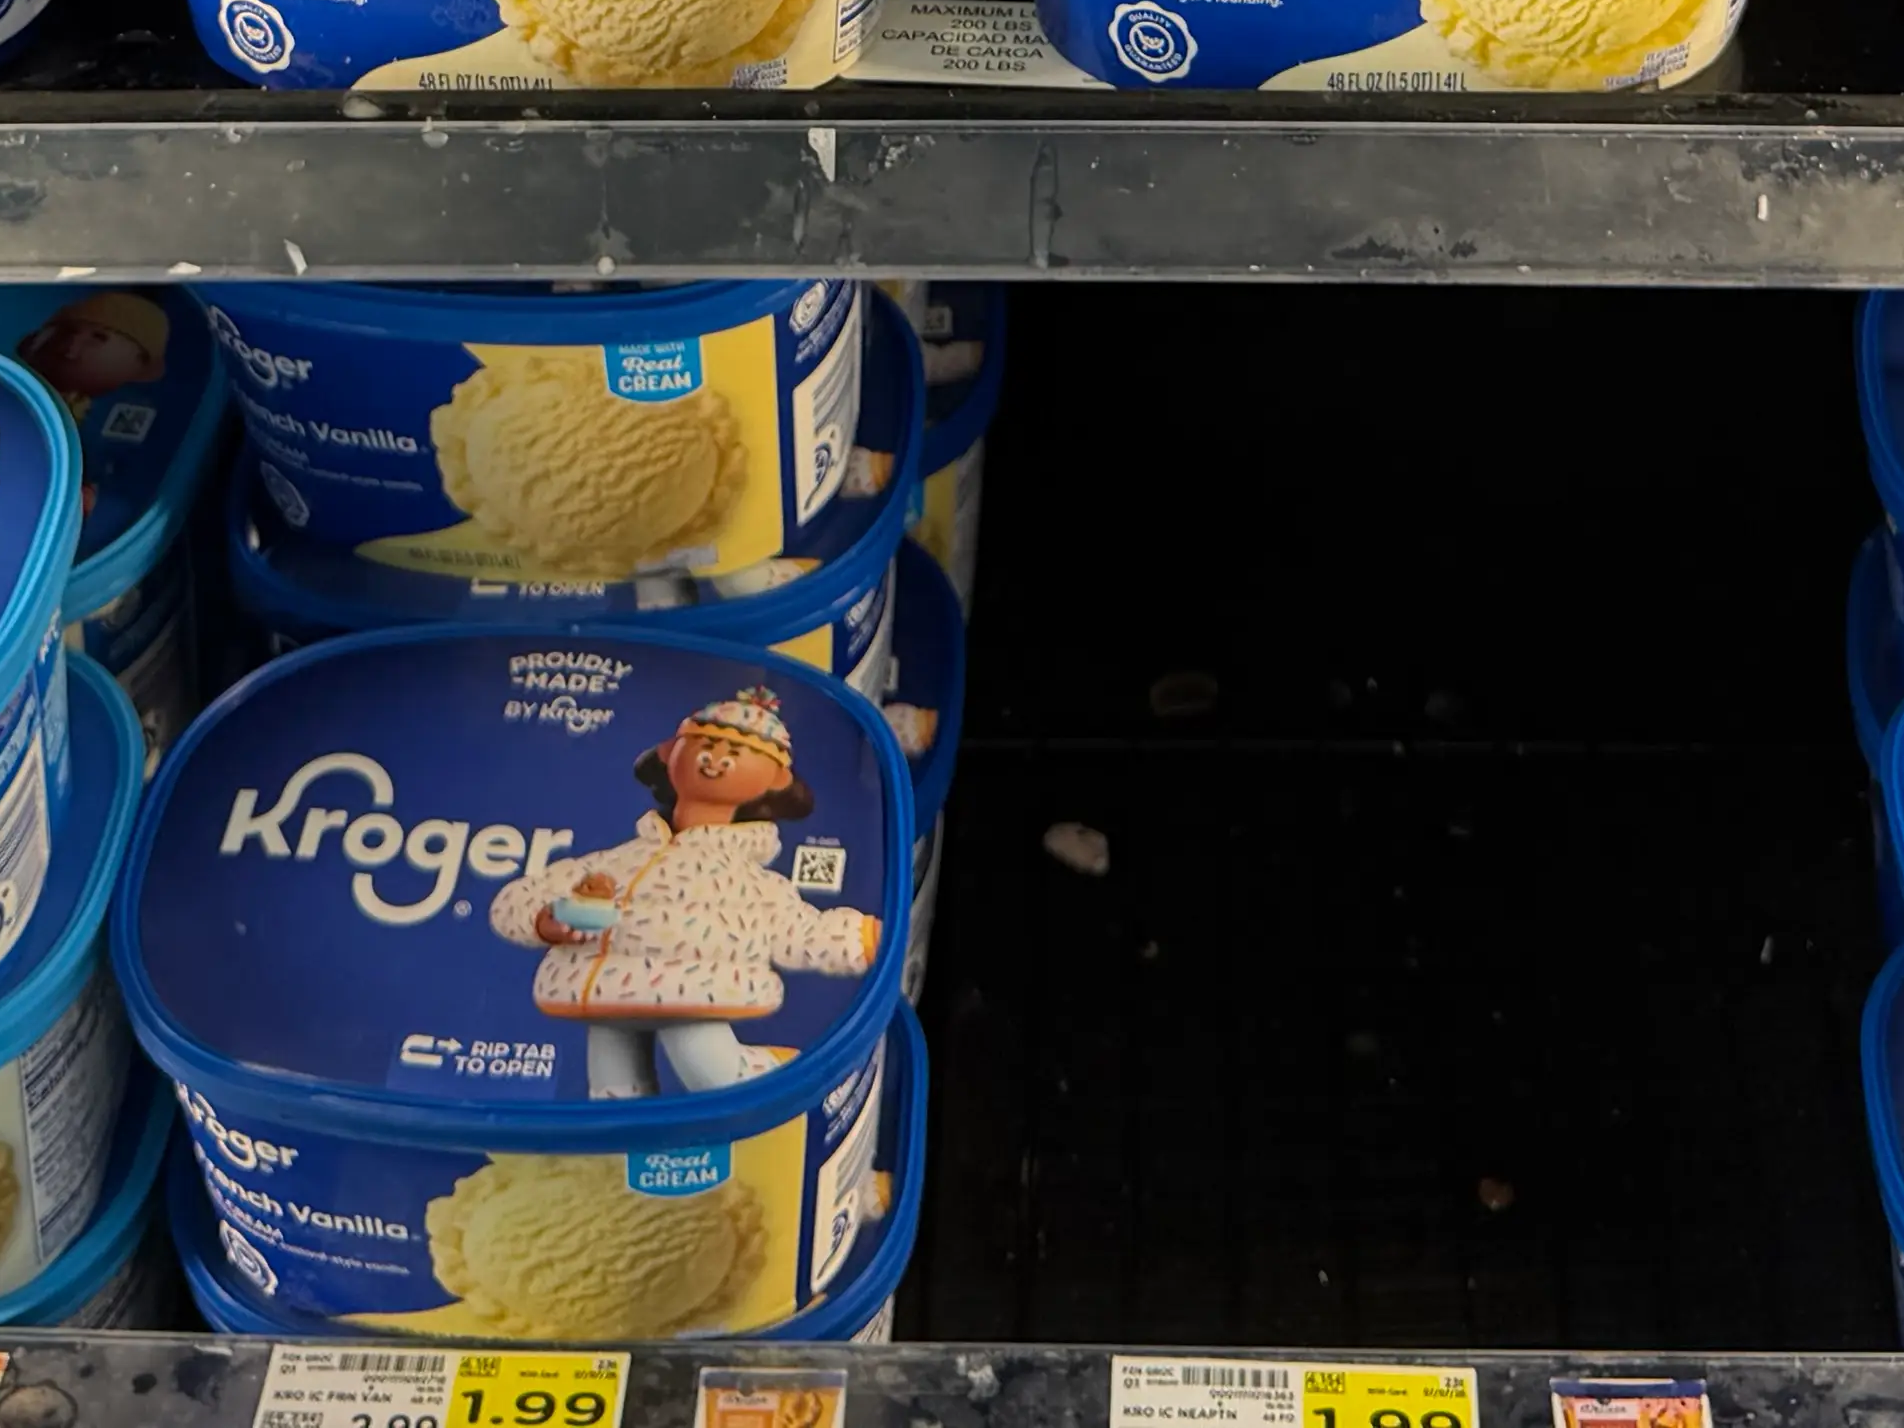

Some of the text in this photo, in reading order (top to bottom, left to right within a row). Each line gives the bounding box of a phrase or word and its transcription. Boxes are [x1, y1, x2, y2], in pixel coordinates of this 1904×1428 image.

[911, 4, 1013, 17] MAXIMUM
[951, 19, 1032, 31] 200 LBS
[882, 29, 1006, 44] CAPACIDAD
[931, 45, 1044, 58] DE CARGA
[307, 419, 418, 456] Vanilla
[219, 753, 575, 927] Kroger
[470, 1042, 557, 1062] RIP TAB
[454, 1056, 555, 1078] TO OPEN
[290, 1199, 409, 1242] Vanilla
